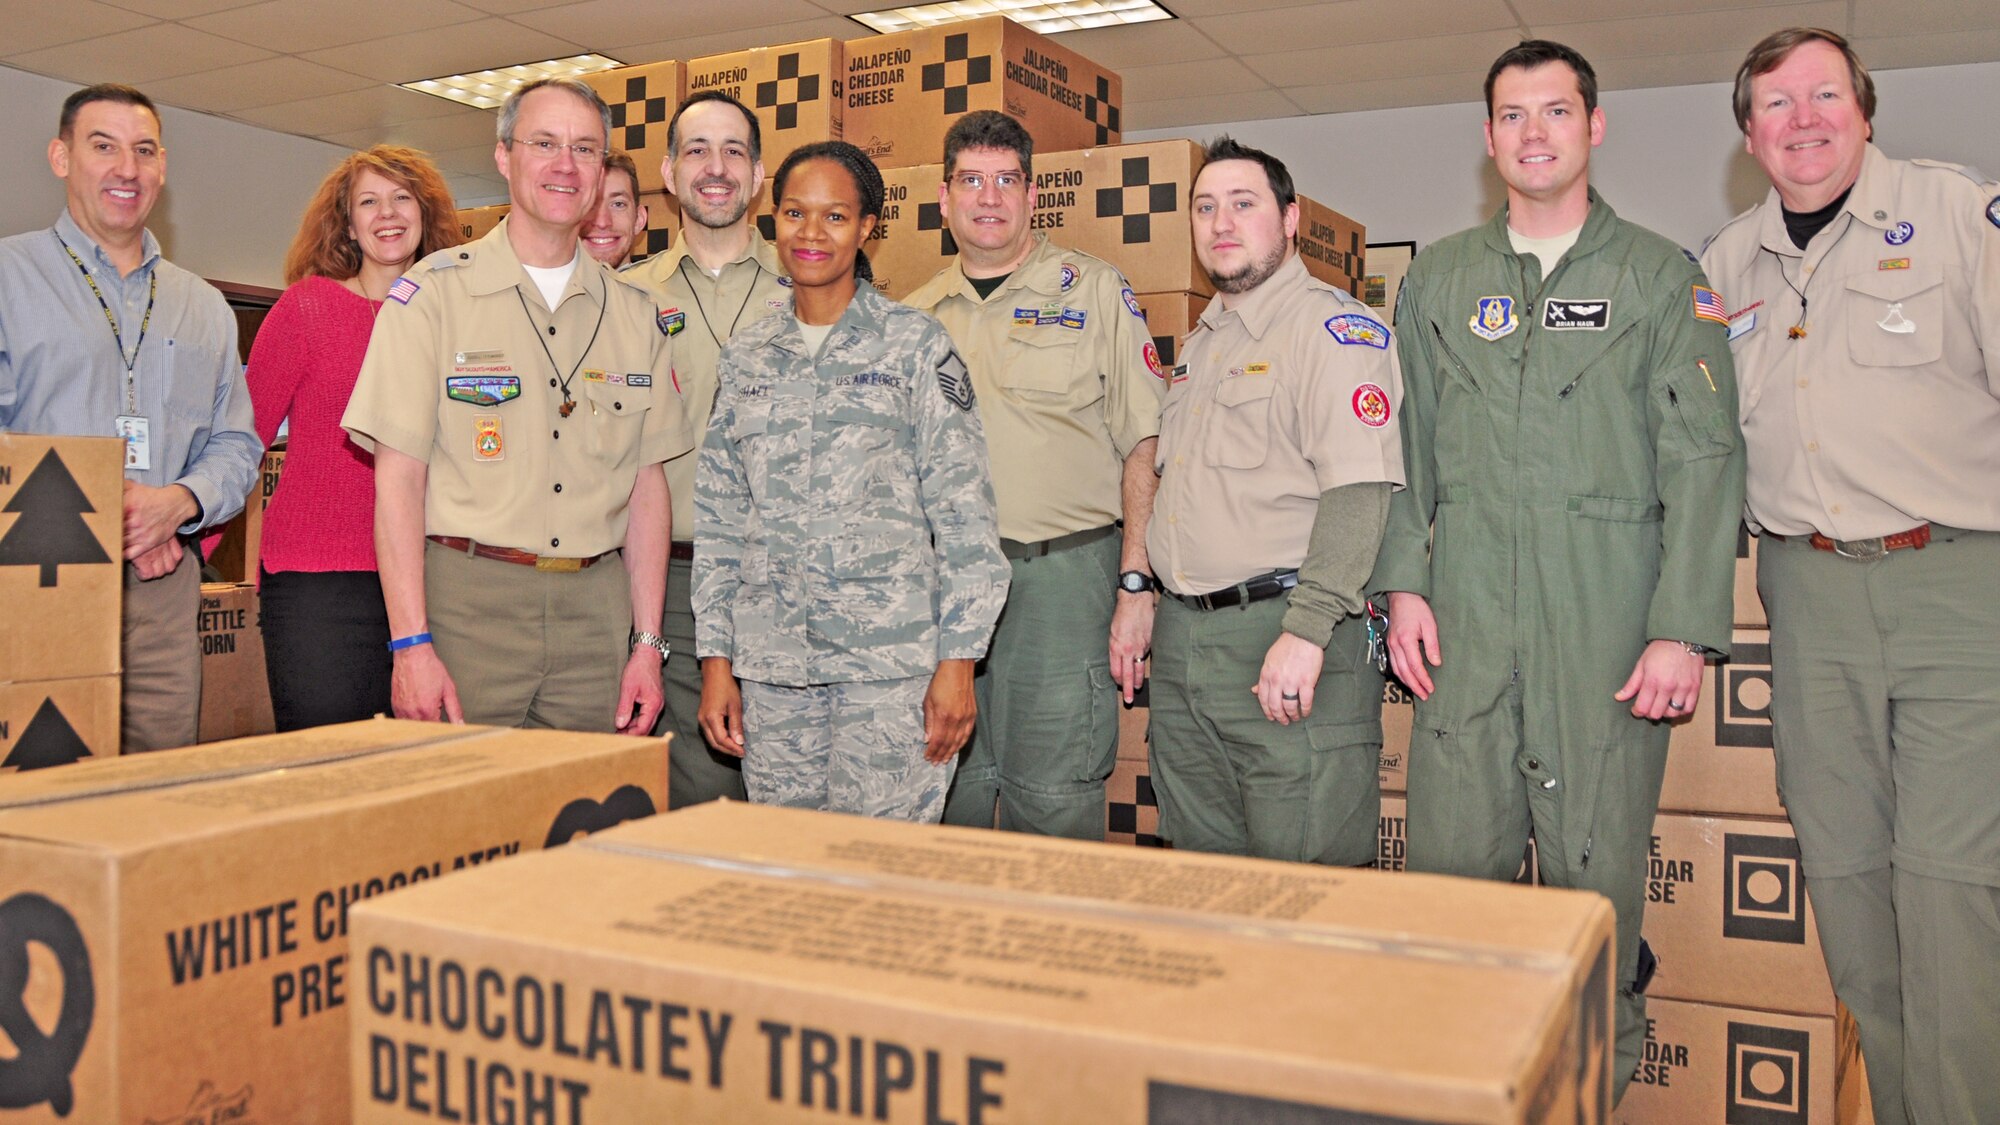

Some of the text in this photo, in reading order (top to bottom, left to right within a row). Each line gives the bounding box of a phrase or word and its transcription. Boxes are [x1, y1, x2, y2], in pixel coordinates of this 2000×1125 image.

[849, 48, 911, 72] JALAPEÑO
[1023, 48, 1068, 84] JALAPEÑO
[691, 66, 748, 90] JALAPEÑO
[849, 68, 904, 90] CHEDDAR
[1006, 61, 1082, 112] CHEDDAR CHEESE
[848, 88, 894, 108] CHEESE
[1034, 191, 1075, 210] DDAR
[1300, 236, 1343, 269] CHEDDAR CHEESE
[853, 373, 868, 385] AIR
[871, 372, 902, 389] FORCE
[1647, 858, 1694, 883] DAR
[166, 900, 298, 986] WHITE
[273, 954, 348, 1027] PRE
[368, 945, 1006, 1125] CHOCOLATEY TRIPLE
[1641, 1041, 1689, 1068] DAR
[370, 1033, 591, 1125] DELIGHT
